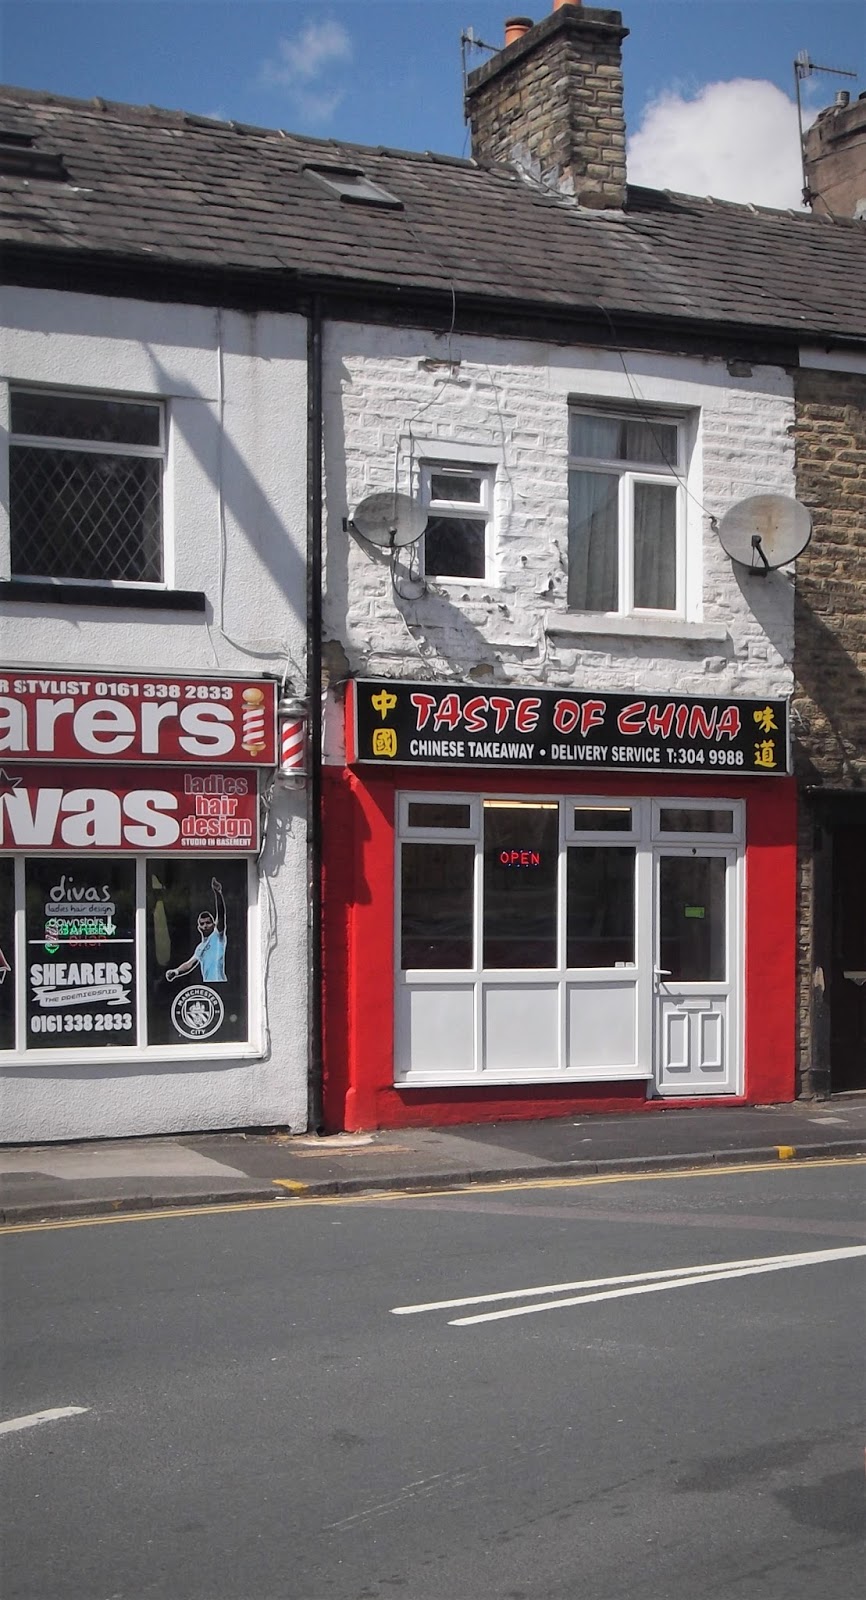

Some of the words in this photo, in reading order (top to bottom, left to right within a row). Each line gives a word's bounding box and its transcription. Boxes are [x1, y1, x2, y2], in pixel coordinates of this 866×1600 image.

[14, 680, 91, 695] STYLIST
[95, 682, 139, 697] 0161
[143, 684, 181, 698] 338
[185, 686, 233, 700] 2833
[371, 689, 398, 758] 中國
[410, 693, 542, 734] TASTE
[553, 699, 606, 737] OF
[617, 701, 742, 742] CHINA
[753, 706, 779, 768] 味道
[410, 739, 465, 758] CHINESE
[467, 742, 535, 760] TAKEAWAY
[551, 743, 608, 761] DELIVERY
[611, 747, 661, 763] SERVICE
[666, 748, 704, 765] T:304
[709, 750, 744, 766] 9988
[184, 774, 249, 796] ladies
[195, 795, 238, 816] hair
[0, 787, 180, 847] vas
[181, 815, 252, 838] design
[181, 838, 207, 846] STUDIO
[207, 838, 216, 846] IN
[216, 838, 251, 846] BASEMENT
[500, 852, 540, 864] OPEN
[50, 875, 111, 902] divas
[48, 905, 69, 913] ladies
[70, 905, 87, 913] hair
[88, 905, 113, 914] design
[49, 917, 104, 926] downstairs
[30, 962, 133, 986] SHEARERS
[177, 989, 218, 1007] MANCHESTER
[31, 1015, 62, 1033] 0161
[64, 1014, 93, 1032] 338
[95, 1013, 132, 1031] 2833
